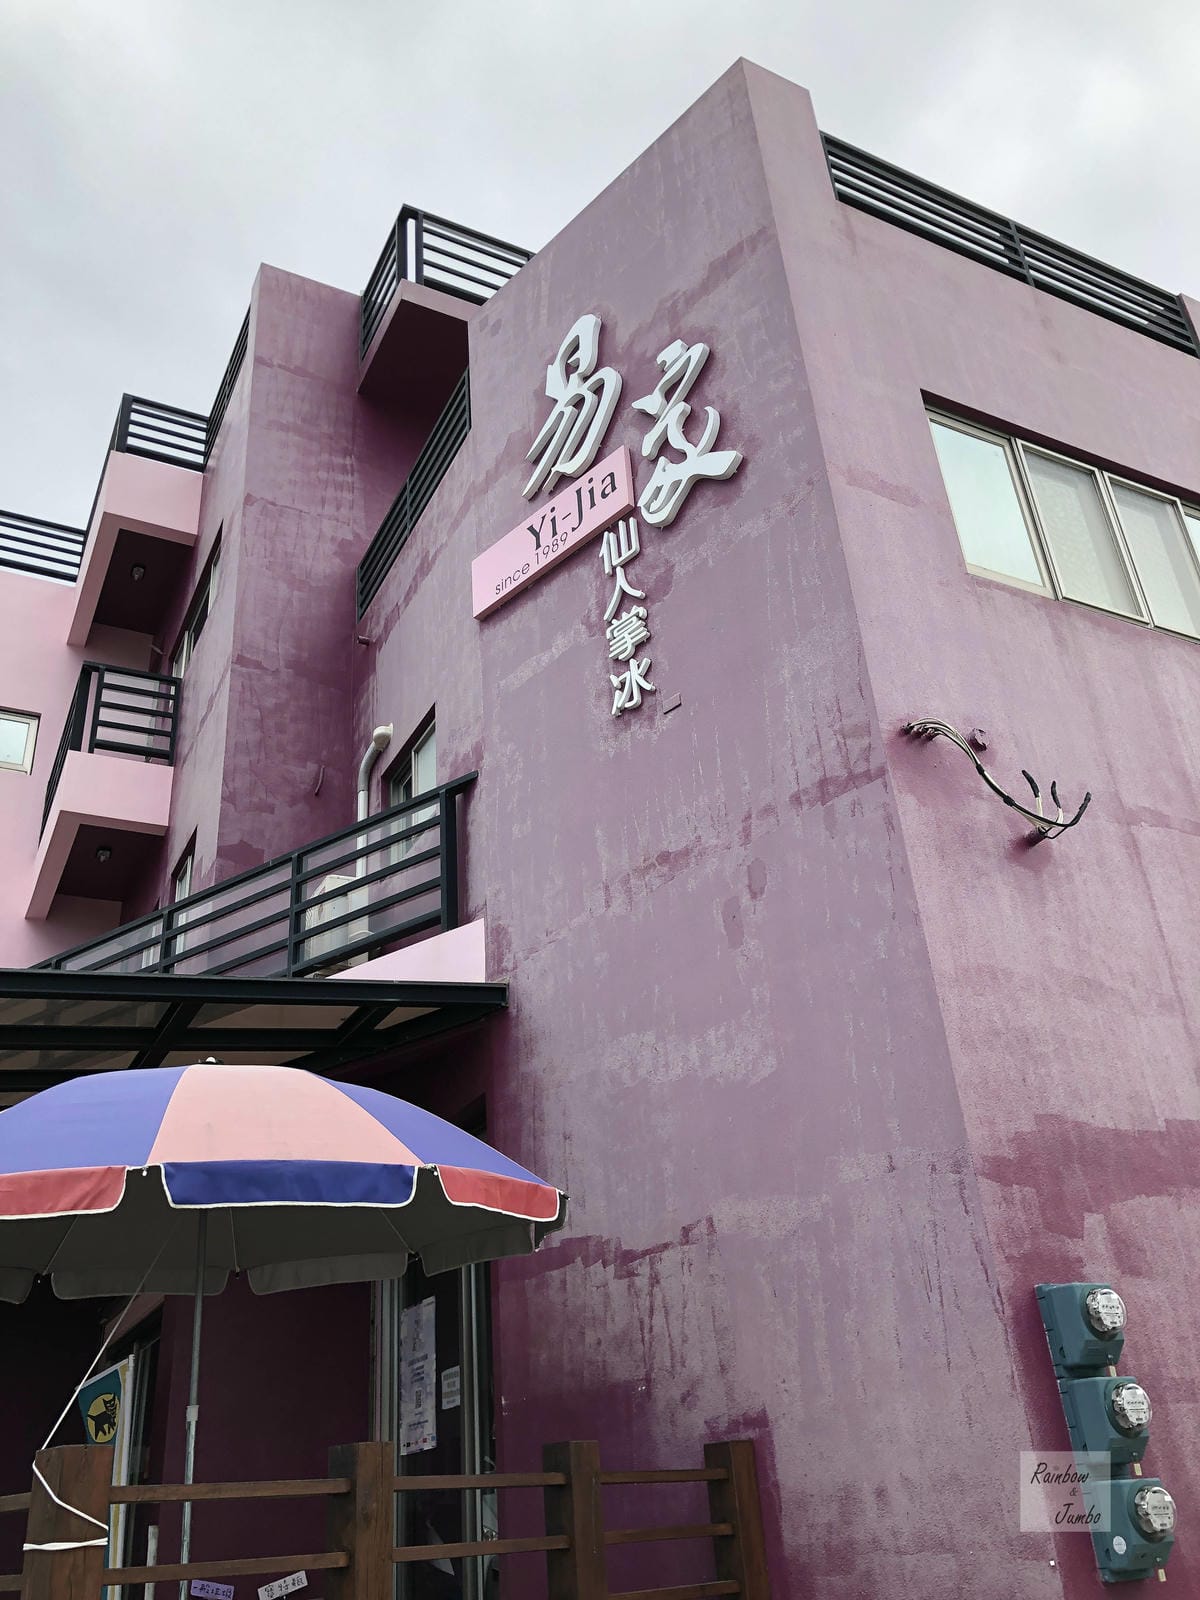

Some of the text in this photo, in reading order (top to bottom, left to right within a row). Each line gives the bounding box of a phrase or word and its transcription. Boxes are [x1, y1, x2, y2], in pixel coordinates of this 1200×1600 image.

[526, 471, 618, 551] Yi-Jia
[495, 531, 568, 595] since 1989
[599, 517, 656, 718] 仙人掌冰
